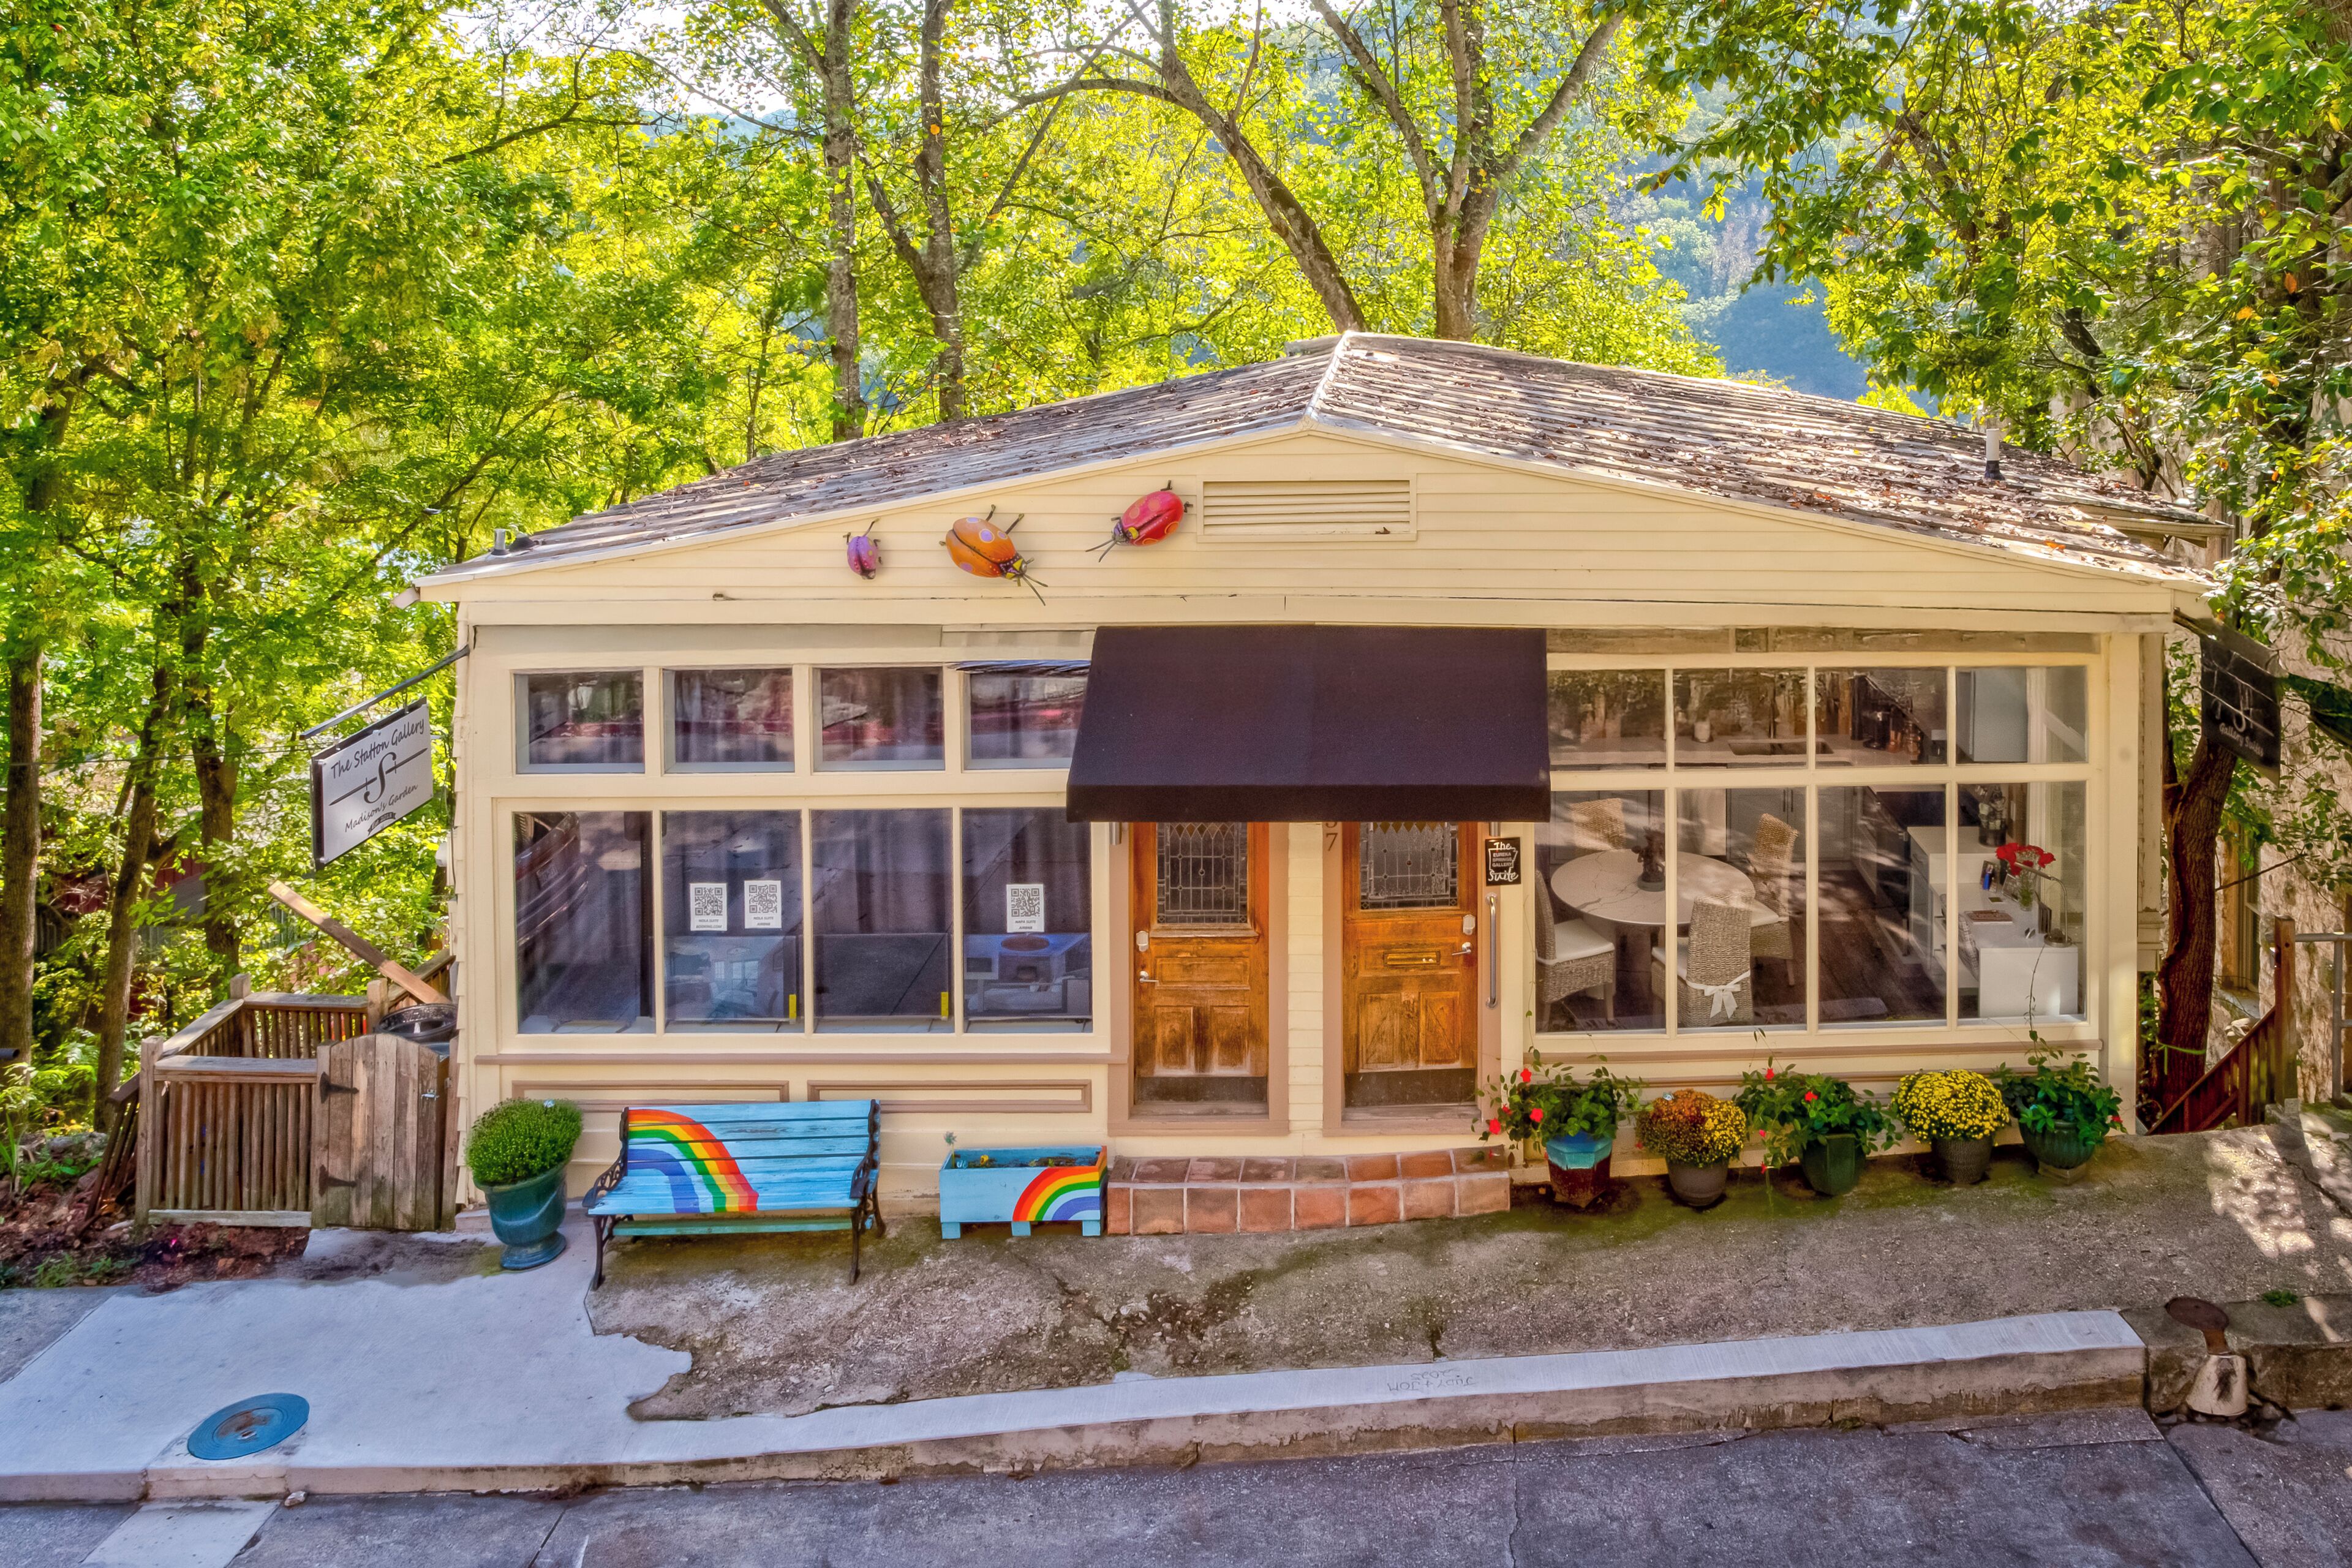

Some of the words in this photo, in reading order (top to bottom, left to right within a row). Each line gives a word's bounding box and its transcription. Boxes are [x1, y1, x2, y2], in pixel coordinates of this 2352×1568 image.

[2219, 722, 2244, 747] Gallery
[331, 759, 352, 779] The
[354, 741, 390, 768] Statton
[391, 718, 424, 746] Gallery
[345, 801, 387, 832] Madison's
[388, 784, 419, 806] Garden
[1493, 842, 1512, 850] The
[1488, 869, 1519, 882] Suite
